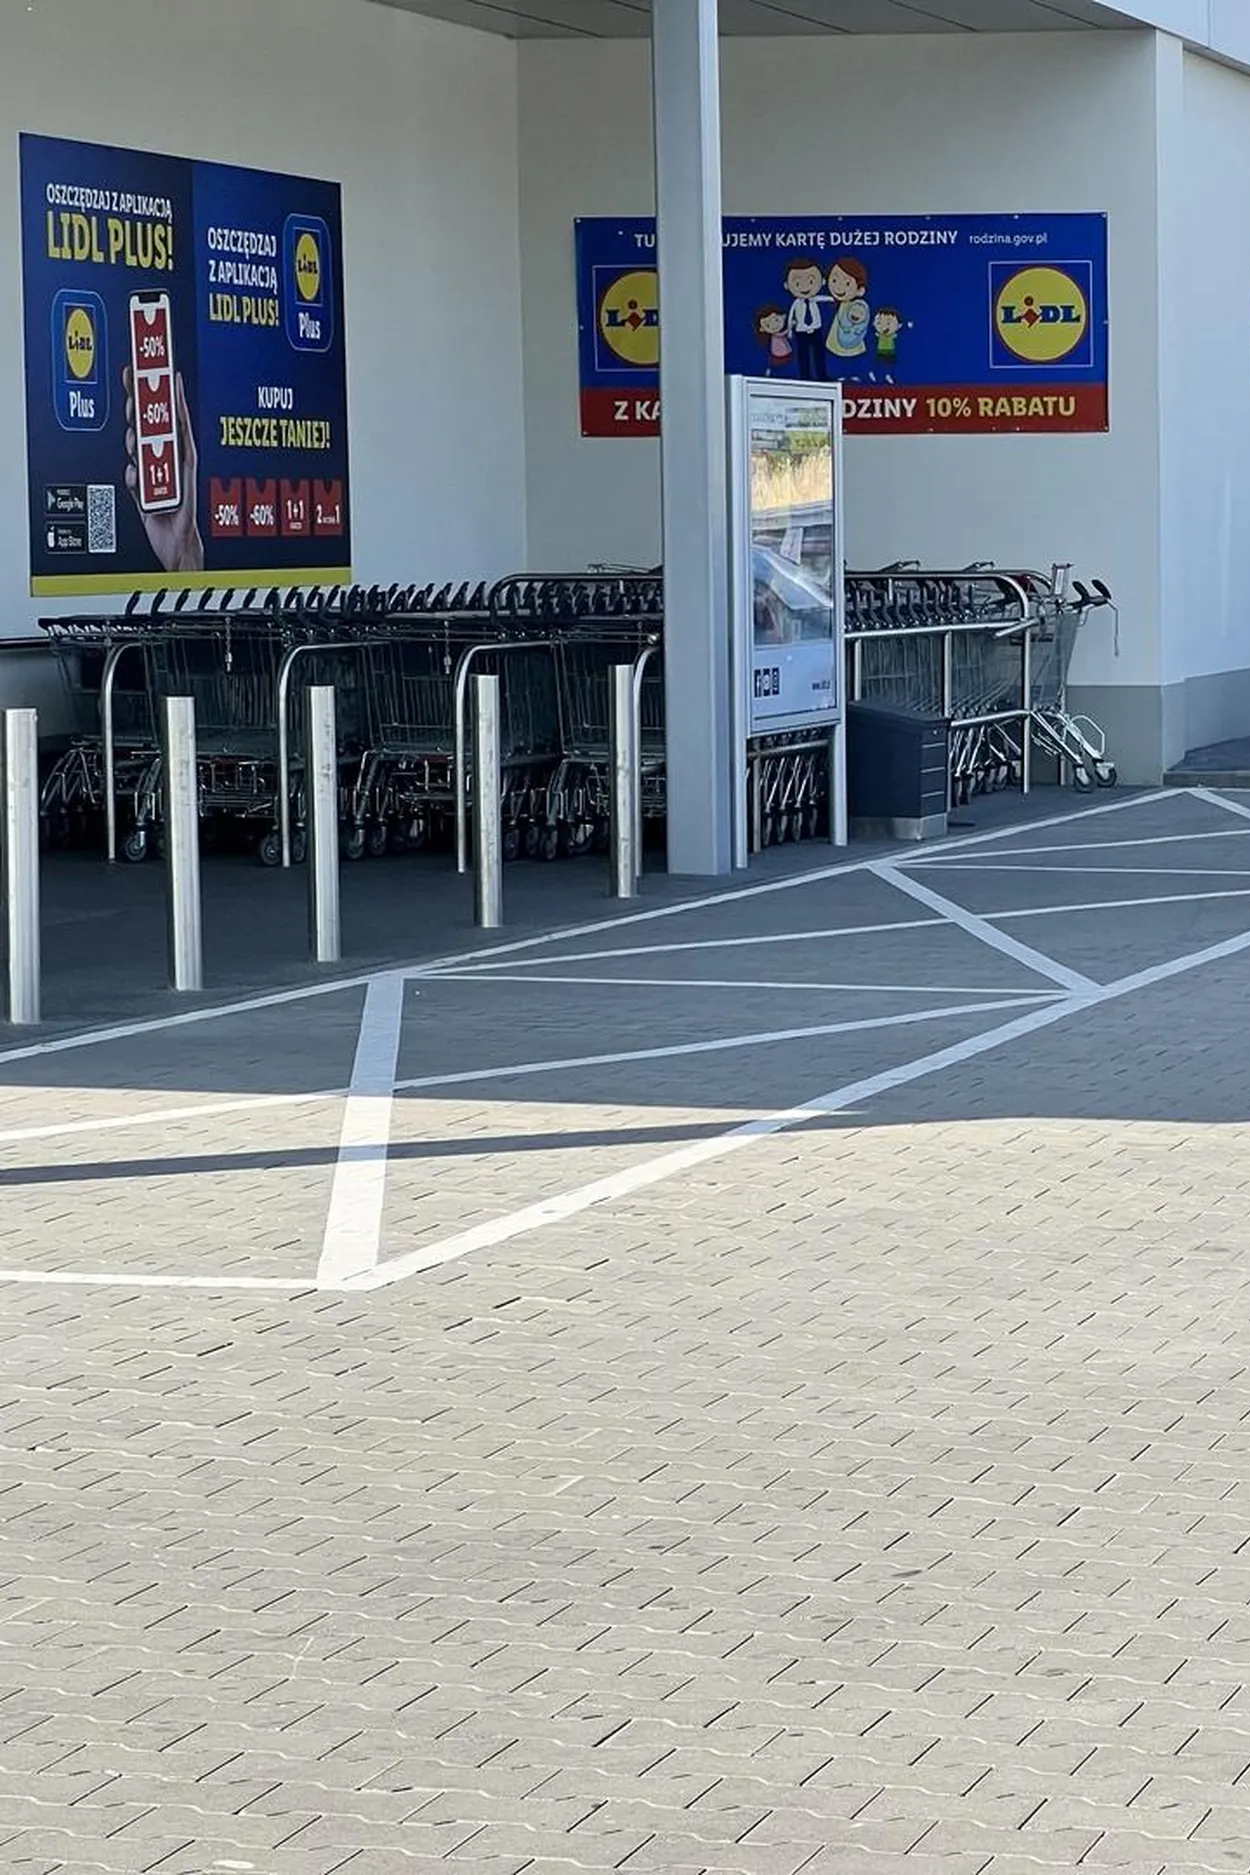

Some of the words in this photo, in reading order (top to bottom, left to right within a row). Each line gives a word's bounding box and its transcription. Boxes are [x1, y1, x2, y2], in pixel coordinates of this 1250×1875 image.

[46, 183, 110, 211] OSZCZĘDZAJ
[111, 193, 120, 210] Z
[119, 194, 173, 219] APLIKACJĄ
[47, 211, 104, 262] LIDL
[107, 218, 174, 271] PLUS!
[207, 226, 277, 258] OSZCZĘDZAJ
[775, 231, 826, 249] KARTĘ
[829, 229, 880, 246] DUŻEJ
[883, 229, 958, 246] RODZINY
[969, 233, 1048, 247] rodzina.gov.pl
[208, 260, 217, 282] Z
[217, 262, 278, 294] APLIKACJĄ
[209, 294, 240, 323] LIDL
[242, 297, 280, 326] PLUS!
[298, 312, 321, 340] Plus
[139, 336, 165, 358] -50%
[69, 391, 95, 418] Plus
[257, 386, 293, 410] KUPUJ
[613, 401, 629, 420] Z
[925, 397, 972, 419] 10%
[977, 395, 1076, 418] RABATU
[143, 402, 169, 425] -60%
[220, 416, 278, 446] JESZCZE
[279, 418, 331, 449] TANIEJ!
[214, 503, 240, 527] -50%
